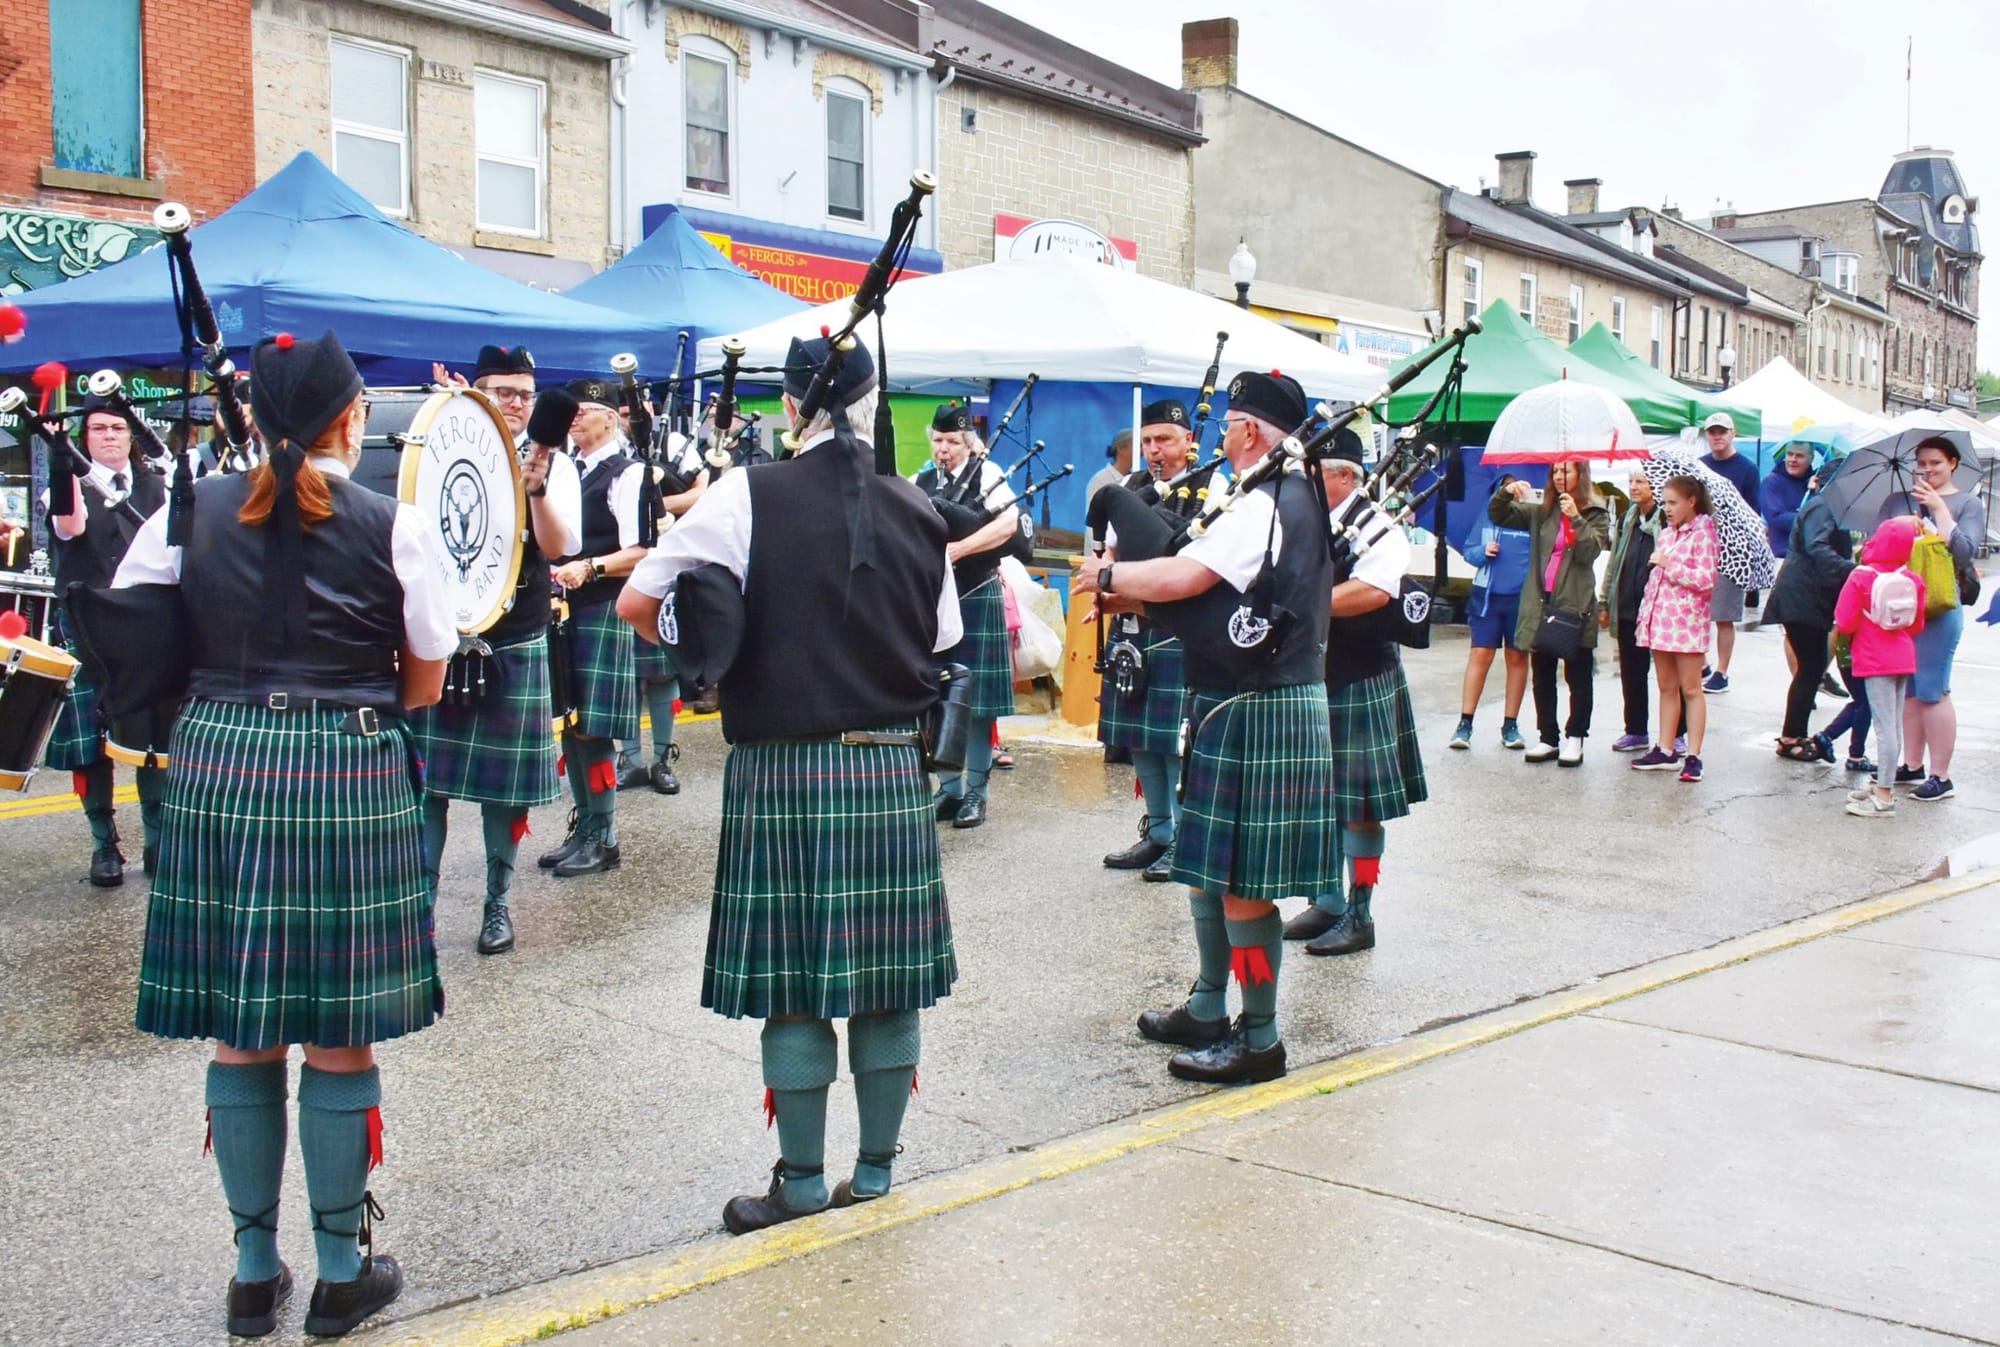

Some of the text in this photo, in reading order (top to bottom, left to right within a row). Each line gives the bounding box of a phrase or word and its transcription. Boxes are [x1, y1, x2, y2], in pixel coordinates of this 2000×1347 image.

[749, 247, 795, 267] FERGUS
[1053, 234, 1095, 249] MADE IN
[737, 262, 820, 299] OTTISH
[429, 415, 499, 474] FERGUS
[474, 534, 505, 600] BAND
